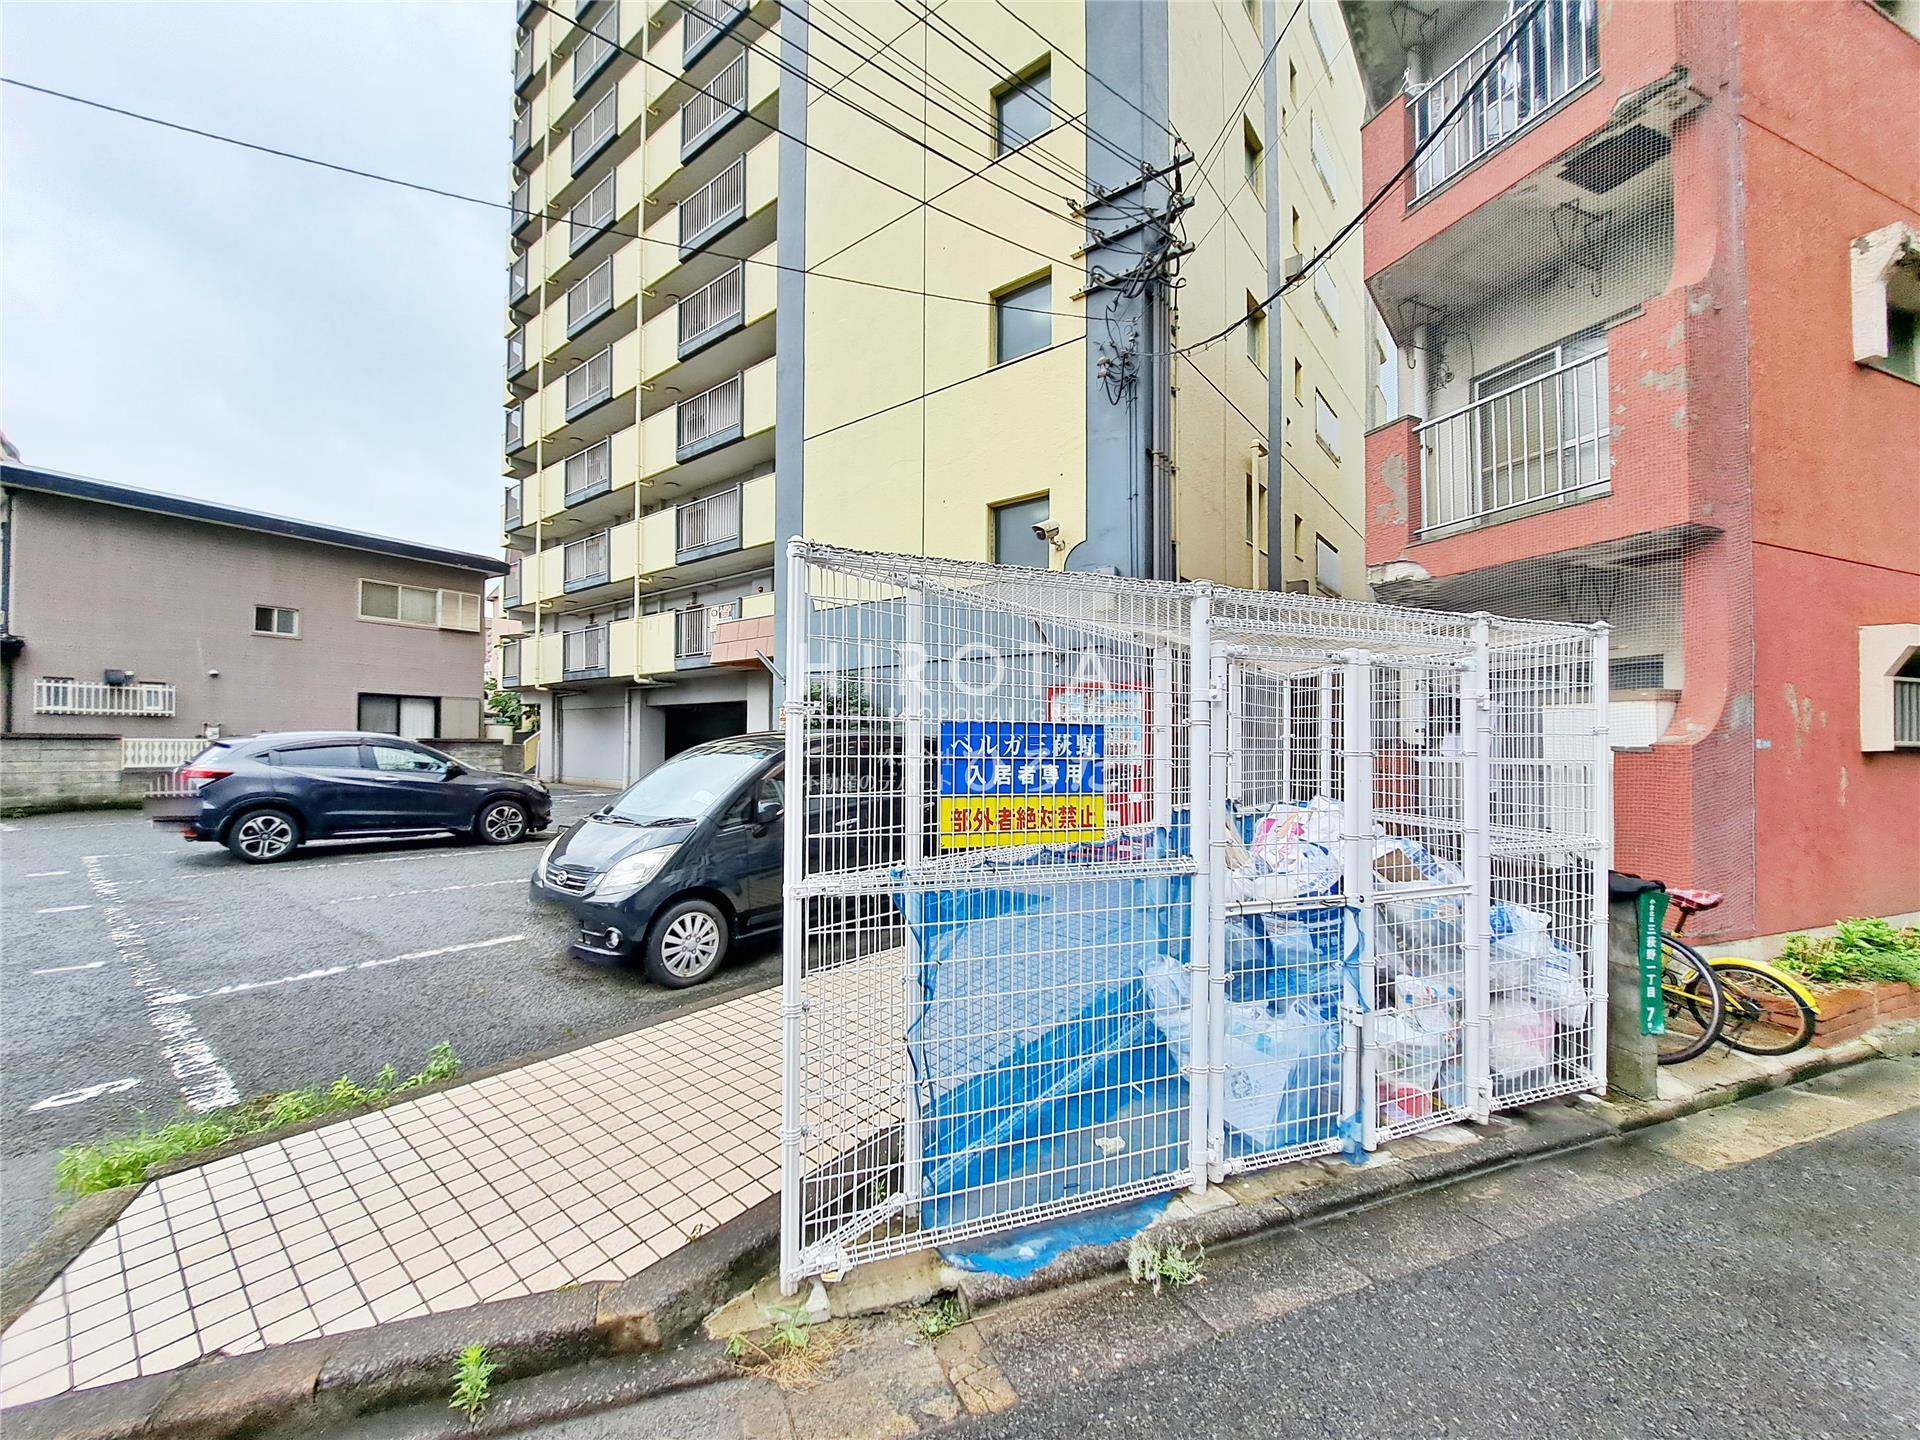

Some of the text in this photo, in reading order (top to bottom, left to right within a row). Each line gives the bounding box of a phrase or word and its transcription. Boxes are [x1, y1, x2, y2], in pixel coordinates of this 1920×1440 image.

[951, 734, 1097, 757] ベルガ三萩野
[967, 764, 1083, 786] 入居者専用
[950, 804, 1097, 833] 部外者絶対禁止
